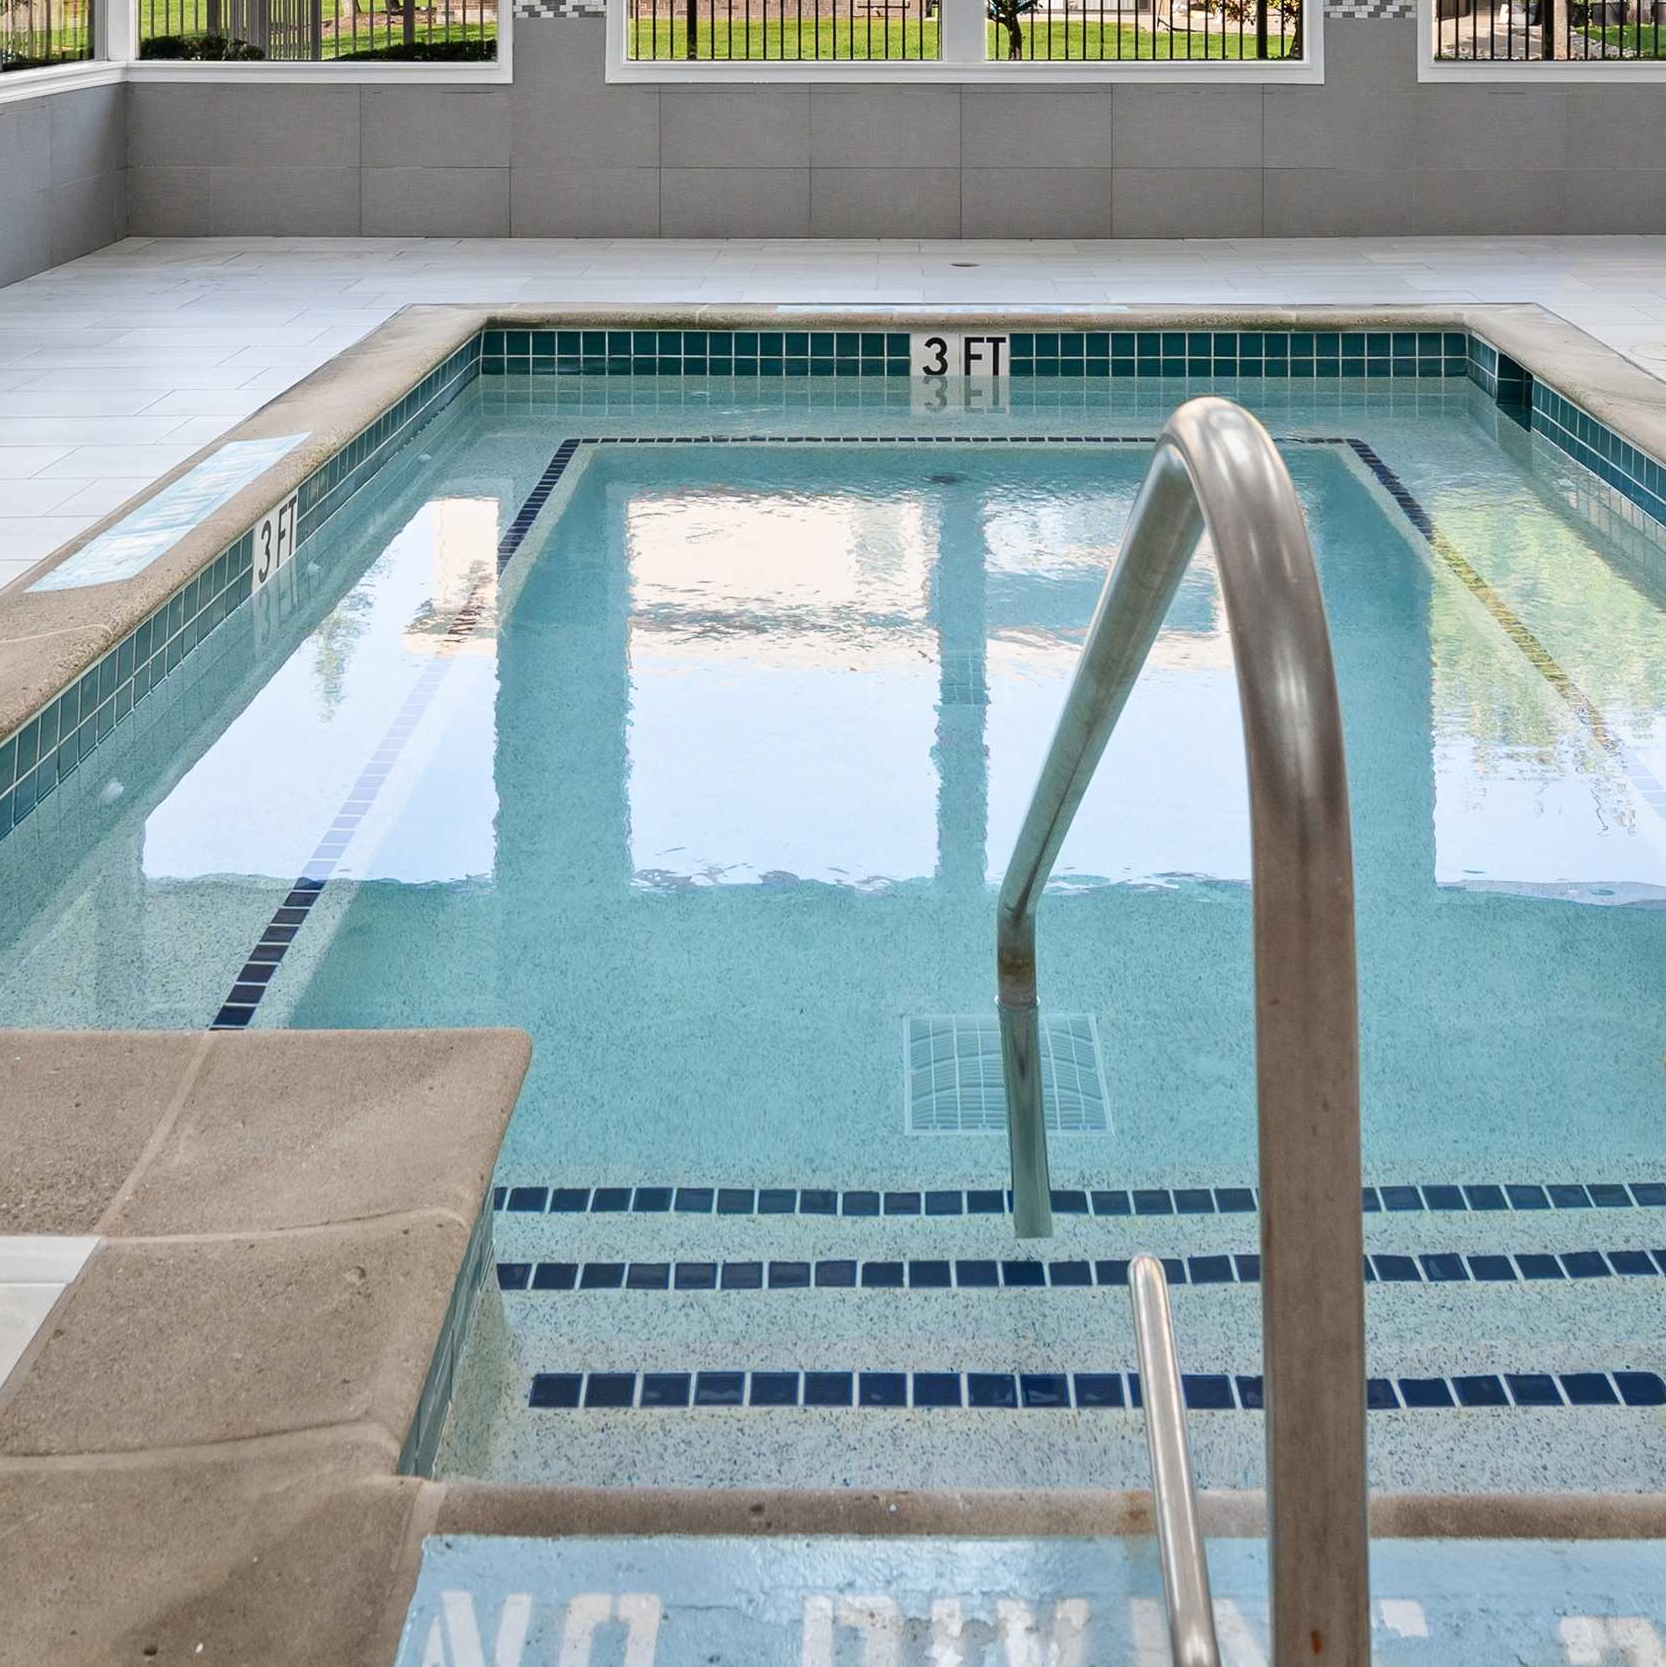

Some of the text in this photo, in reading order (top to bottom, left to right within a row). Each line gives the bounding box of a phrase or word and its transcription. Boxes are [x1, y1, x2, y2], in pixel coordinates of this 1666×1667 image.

[922, 337, 1006, 376] 3 FT
[258, 520, 271, 584] 3
[276, 494, 297, 568] FT
